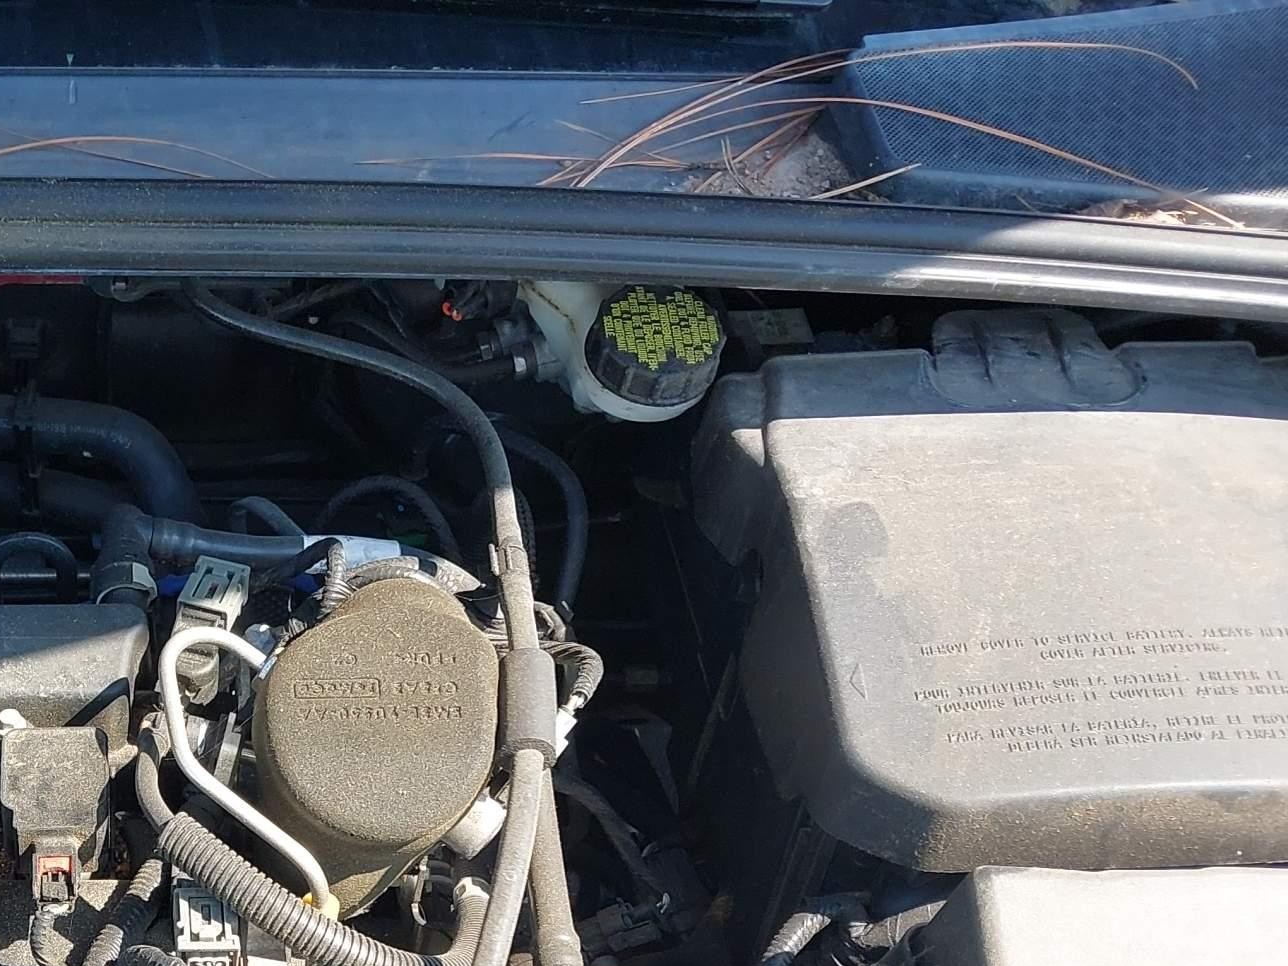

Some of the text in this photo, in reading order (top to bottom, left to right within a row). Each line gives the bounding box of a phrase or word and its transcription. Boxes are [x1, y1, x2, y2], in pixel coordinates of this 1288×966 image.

[668, 302, 678, 322] SEALED
[652, 322, 660, 330] LE
[613, 318, 627, 352] CONTENANT
[678, 308, 687, 318] DOT
[685, 346, 695, 363] FROM
[703, 342, 712, 354] CAP
[695, 350, 704, 362] USE
[979, 638, 1025, 650] COVER
[1031, 636, 1049, 647] TO
[1056, 630, 1116, 645] SERVICE
[1039, 647, 1085, 660] COVER
[1092, 645, 1136, 657] AFTER
[914, 688, 950, 702] POUR
[1052, 677, 1080, 690] SUR
[1012, 692, 1076, 707] REPOSER
[990, 724, 1054, 739] REVISAR
[1070, 735, 1098, 748] SER
